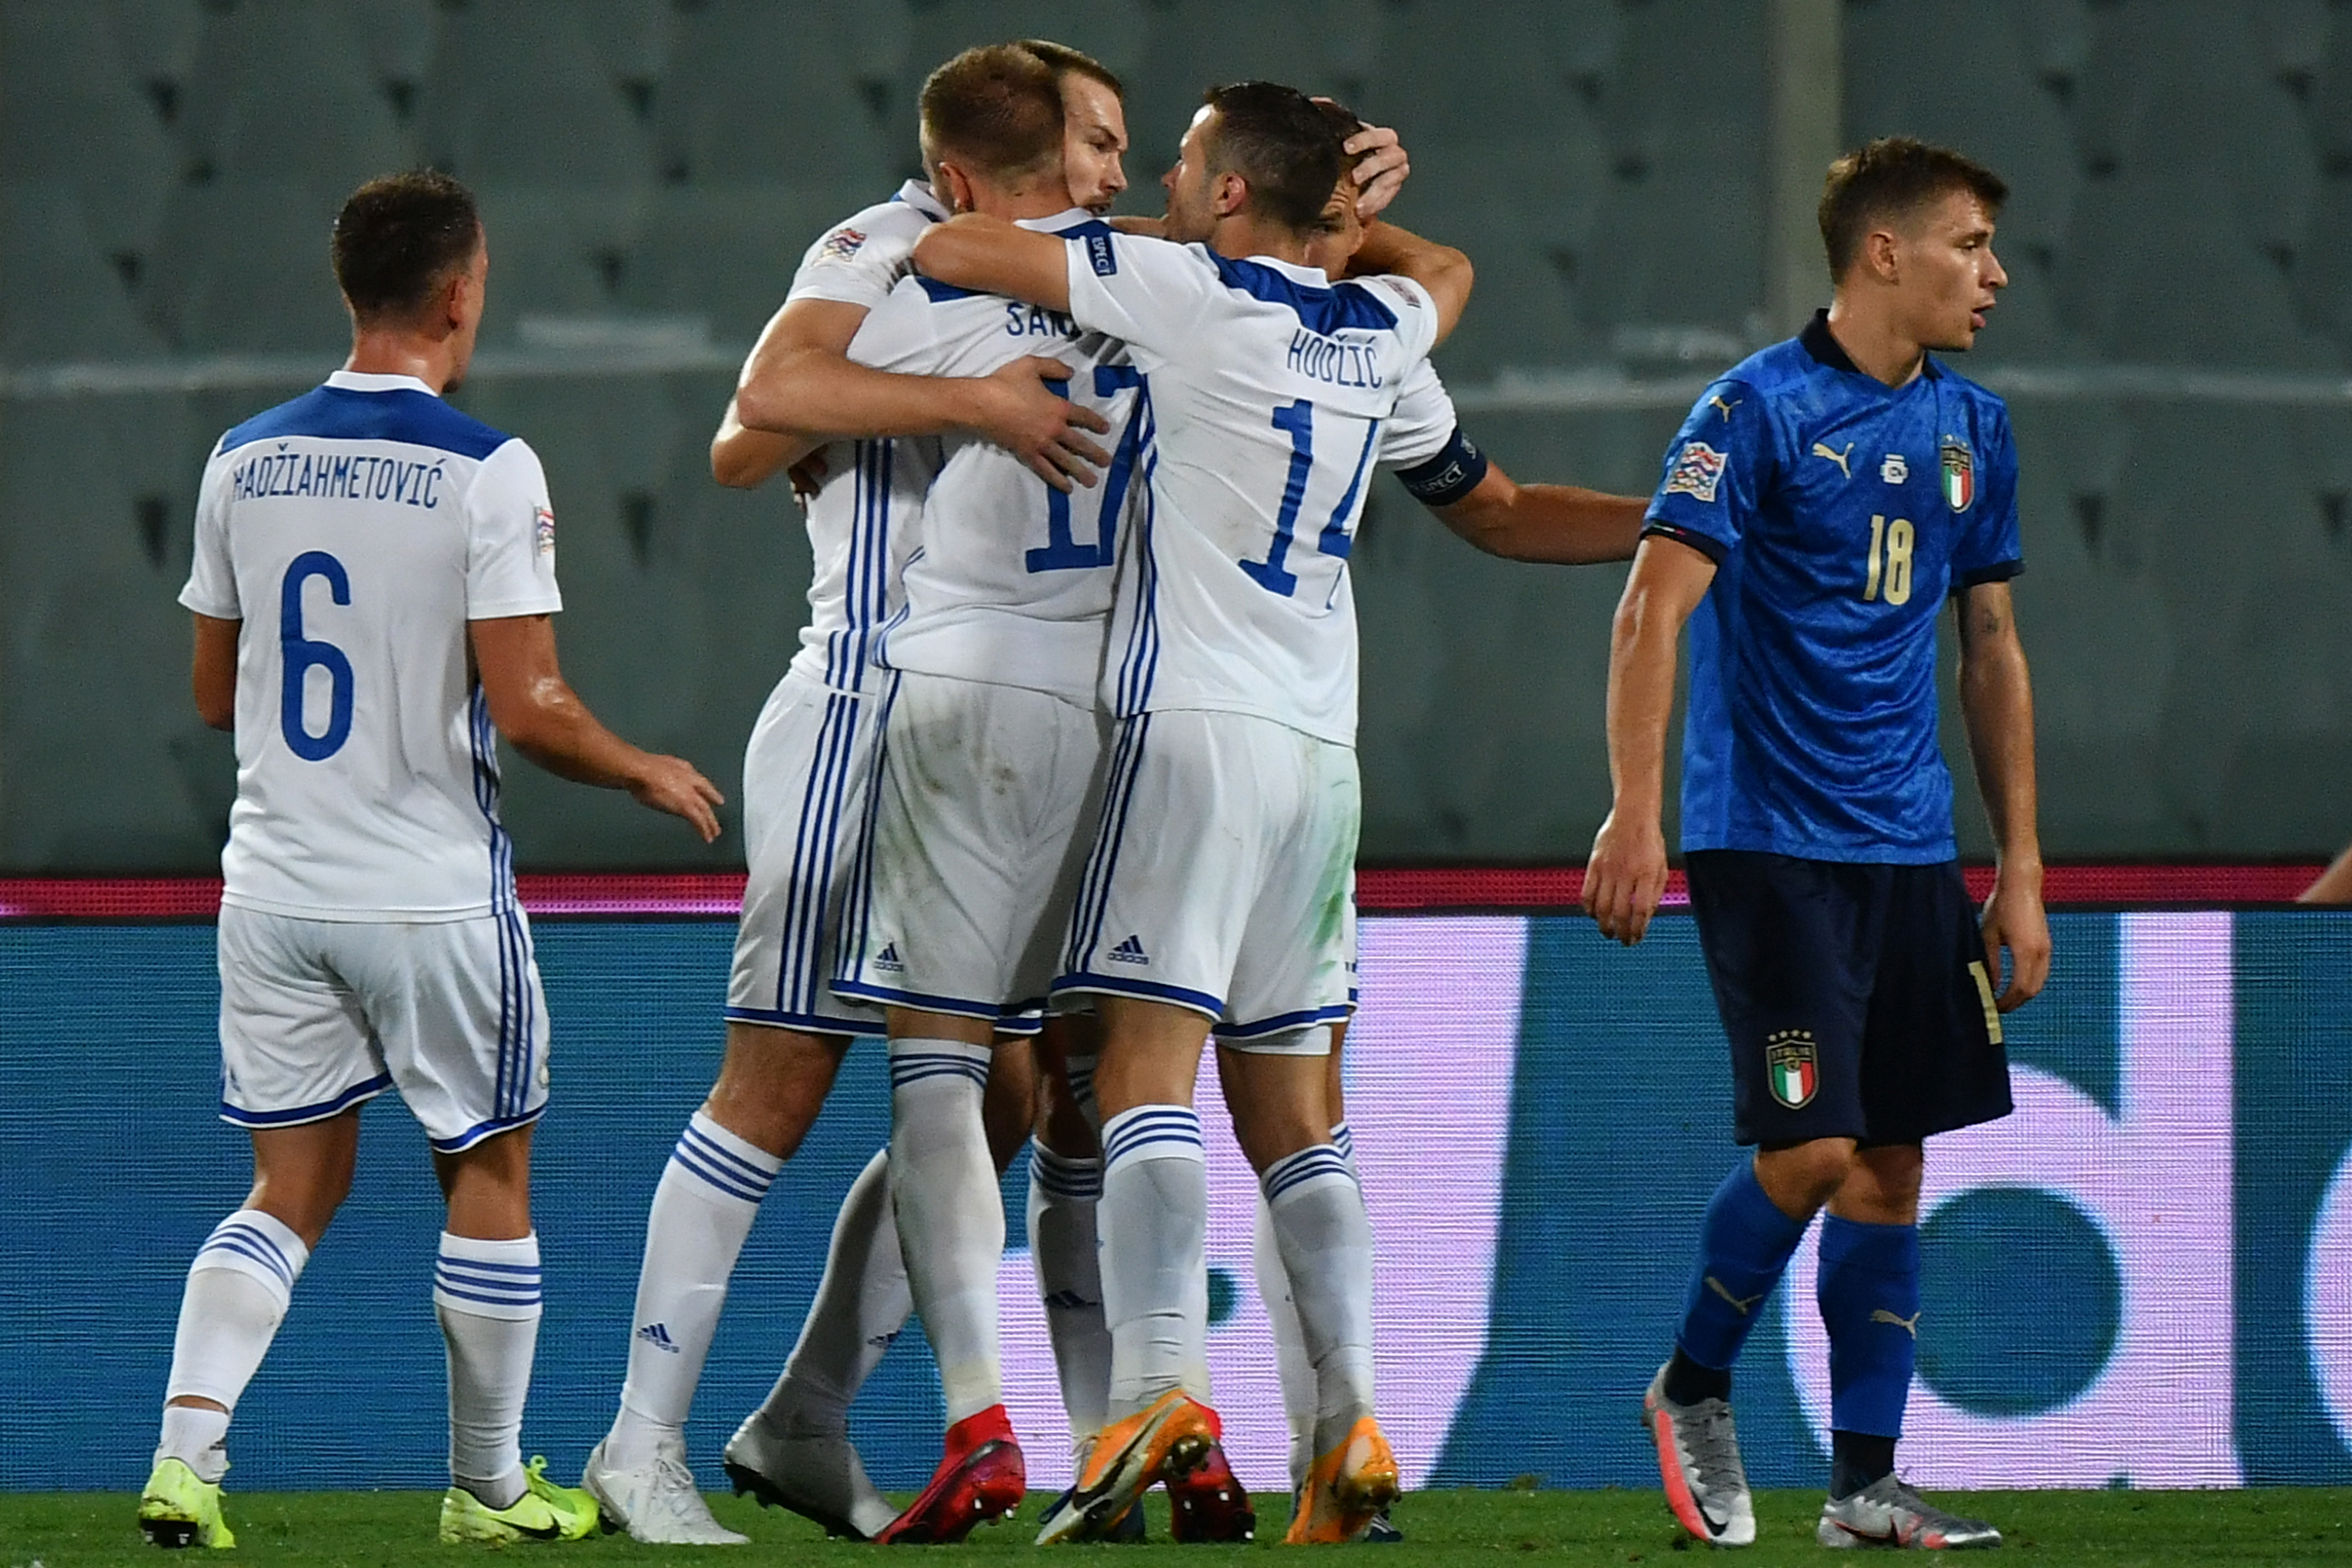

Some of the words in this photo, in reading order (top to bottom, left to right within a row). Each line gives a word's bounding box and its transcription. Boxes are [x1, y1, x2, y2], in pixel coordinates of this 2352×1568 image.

[1092, 236, 1110, 274] ESPECT
[1006, 302, 1079, 339] SAN
[1026, 365, 1139, 574] 17
[1863, 515, 1915, 605] 18
[281, 551, 355, 761] 6
